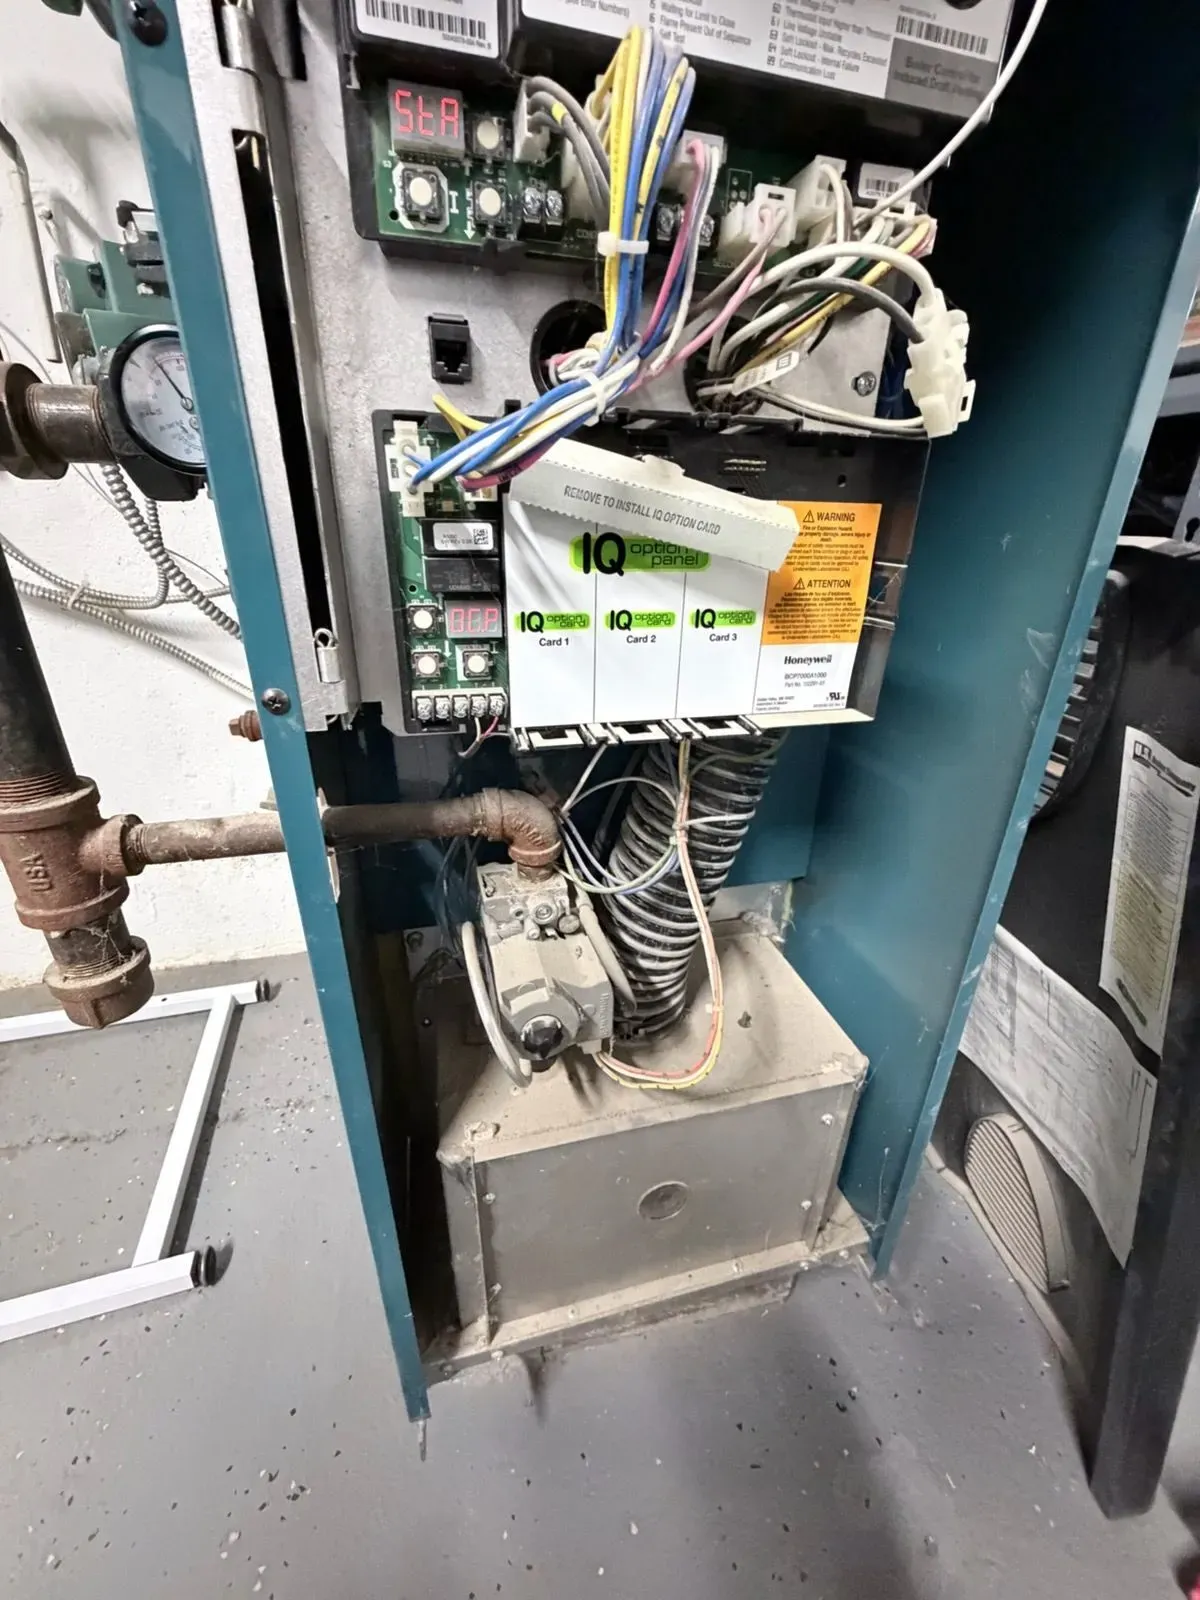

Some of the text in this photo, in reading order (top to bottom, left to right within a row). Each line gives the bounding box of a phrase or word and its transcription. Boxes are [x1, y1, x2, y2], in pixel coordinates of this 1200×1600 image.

[563, 485, 721, 536] REMOVE TO INSTALL IQ OPTION CARD
[816, 512, 856, 522] WARNING
[582, 532, 689, 576] IQ option
[651, 553, 699, 568] panel
[807, 579, 851, 589] ATTENTION
[520, 611, 583, 634] IQ option
[559, 618, 587, 628] card
[609, 609, 669, 632] IQ option
[646, 616, 672, 626] card
[694, 608, 717, 630] IQ
[718, 610, 751, 621] option
[729, 615, 753, 625] card
[538, 637, 570, 647] Card 1
[626, 635, 656, 644] Card 2
[709, 633, 738, 642] Card 3
[784, 654, 833, 666] Honeywell
